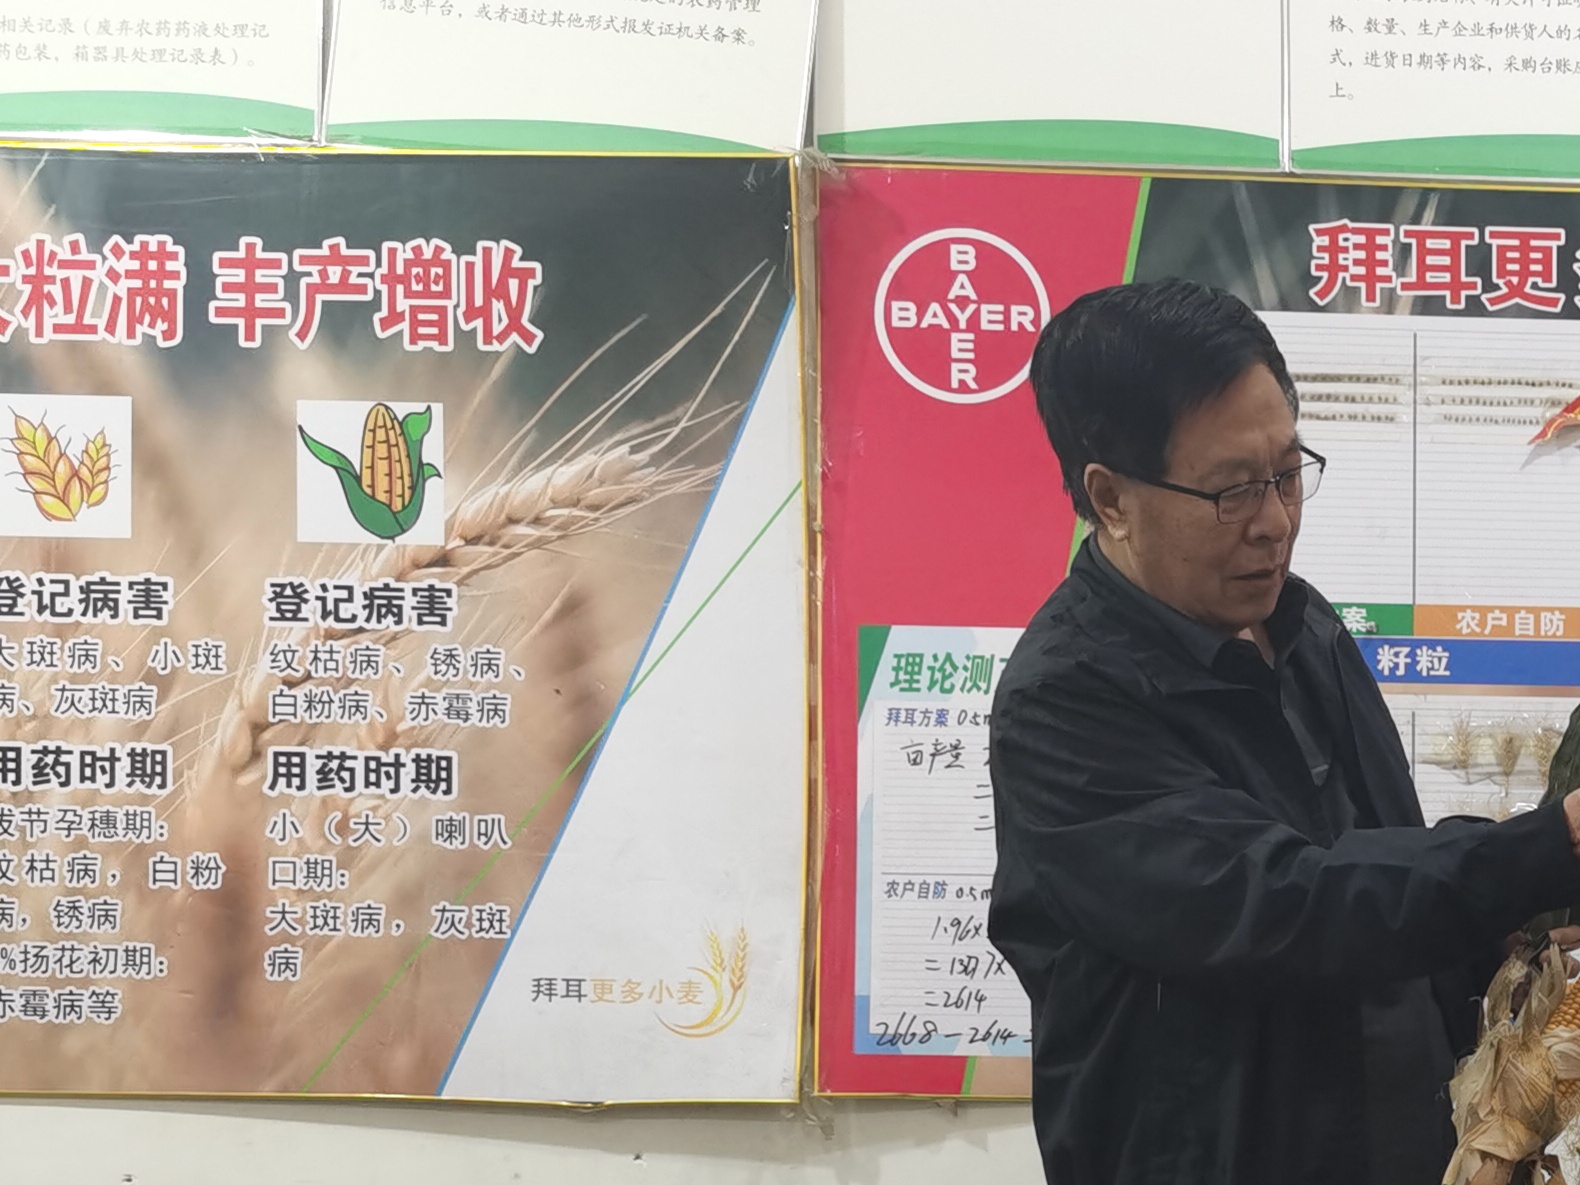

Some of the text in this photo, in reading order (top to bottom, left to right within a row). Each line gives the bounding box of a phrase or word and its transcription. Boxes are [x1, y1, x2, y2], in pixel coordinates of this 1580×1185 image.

[1328, 82, 1355, 101] 上。
[0, 237, 541, 350] 粒满 丰产增收
[891, 300, 1037, 332] BAYER
[947, 243, 979, 390] BAYER
[0, 576, 170, 621] 登记病害
[268, 581, 454, 627] 登记病害
[1455, 609, 1567, 636] 农户自防
[269, 643, 526, 680] 纹枯病、锈病、
[889, 652, 1009, 695] 理论测
[1377, 645, 1450, 676] 籽粒
[269, 689, 508, 725] 白粉病、赤霉病
[885, 707, 949, 728] 拜耳方案
[0, 745, 170, 791] 用药时期
[268, 751, 455, 796] 用药时期
[269, 813, 510, 846] 小（大）喇叭
[269, 856, 349, 890] 口期：
[884, 880, 948, 900] 农户自防
[267, 903, 509, 936] 大斑病，灰斑
[267, 948, 301, 979] 病
[531, 977, 704, 1005] 拜耳更多小麦
